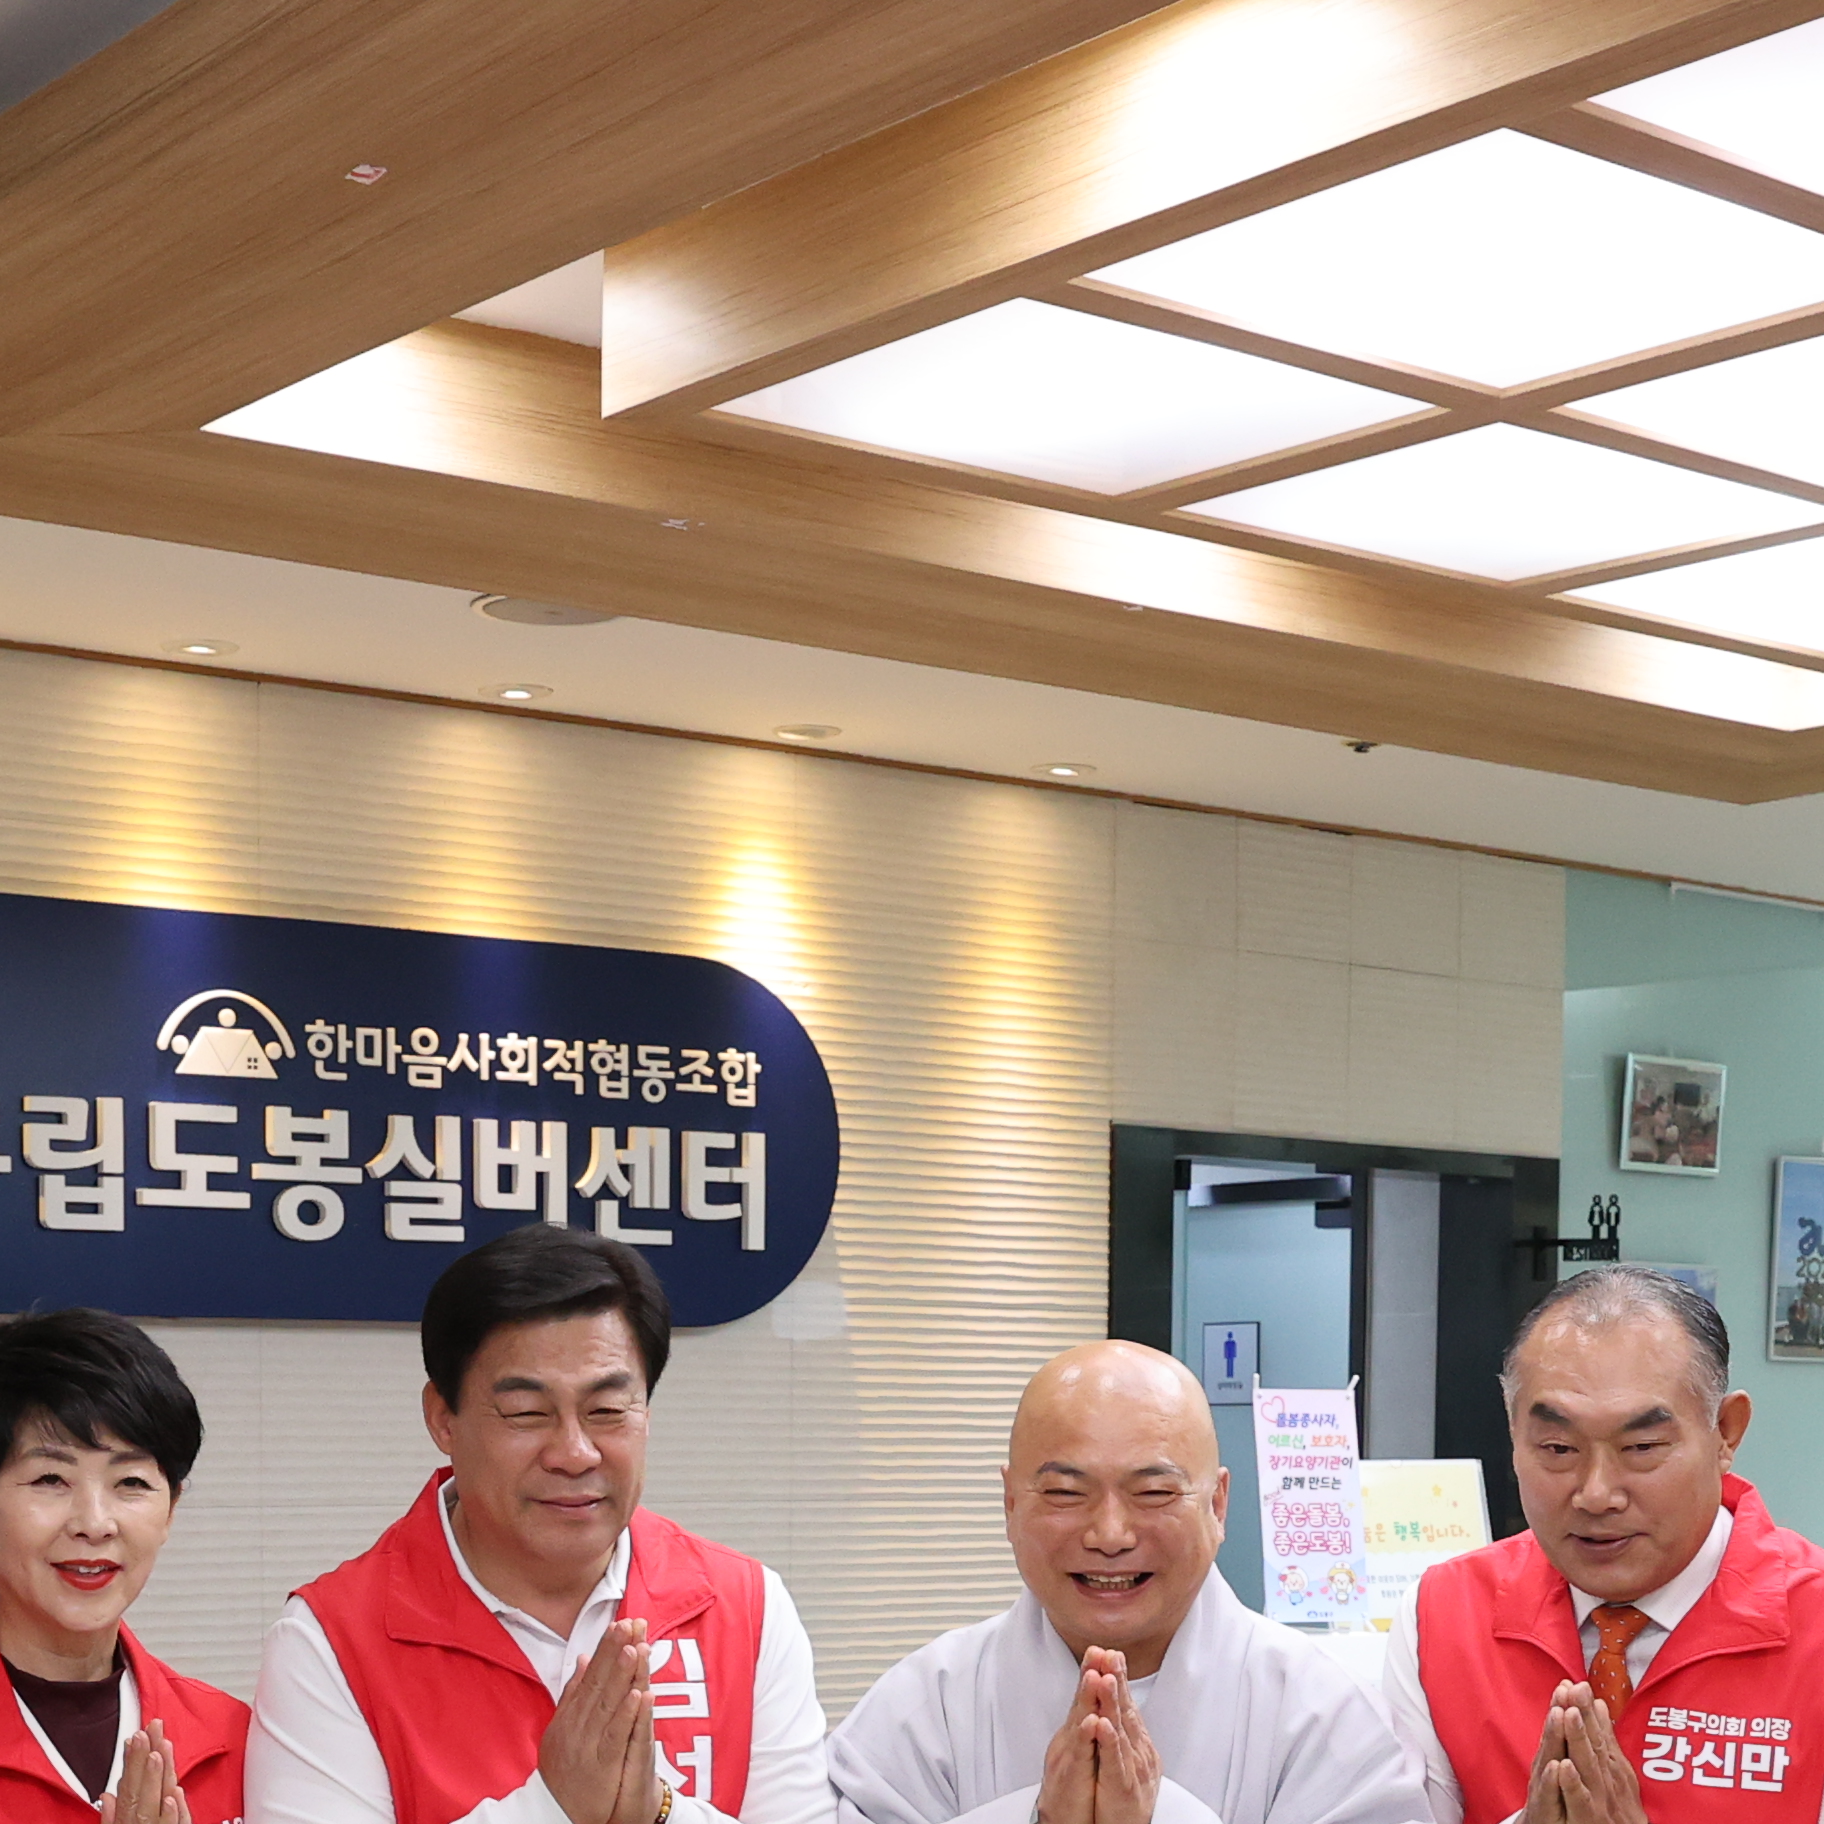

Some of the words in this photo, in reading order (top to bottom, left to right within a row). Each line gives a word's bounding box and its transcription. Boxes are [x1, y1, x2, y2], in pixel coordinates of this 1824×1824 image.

[304, 1018, 763, 1108] 한마음사회적협동조합
[1269, 1455, 1353, 1471] 장기요양기관이
[1282, 1476, 1306, 1490] 함께
[1308, 1477, 1342, 1490] 만드는
[1393, 1521, 1471, 1543] 행복입니다.
[1647, 1706, 1747, 1738] 도봉구의회
[1749, 1717, 1791, 1741] 의장
[1642, 1733, 1790, 1792] 강신만
